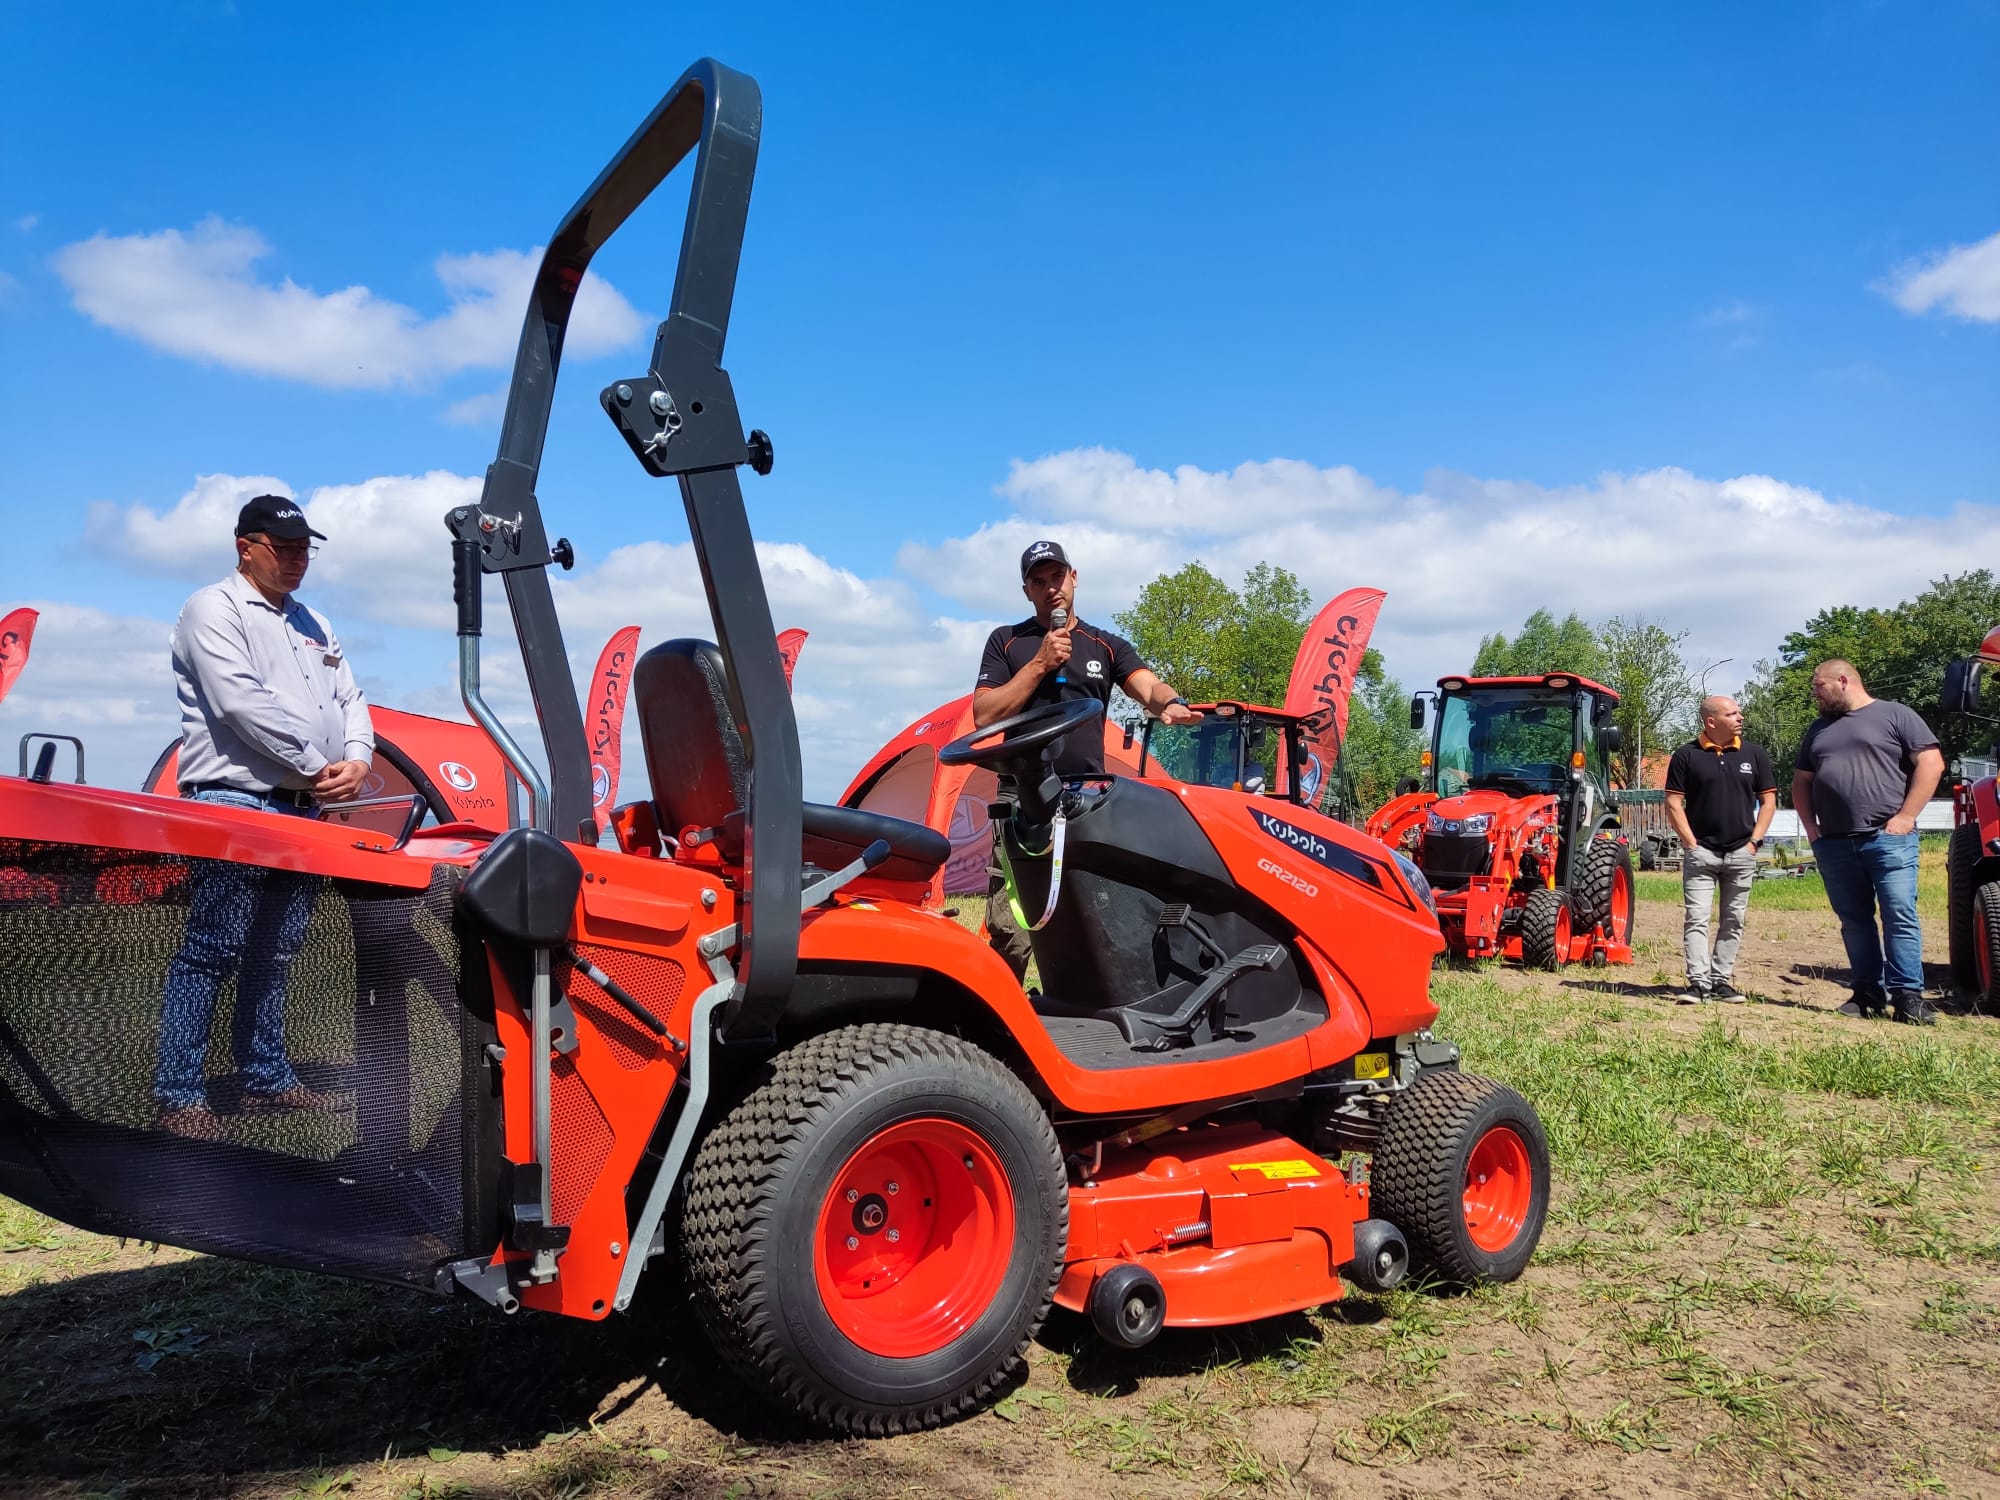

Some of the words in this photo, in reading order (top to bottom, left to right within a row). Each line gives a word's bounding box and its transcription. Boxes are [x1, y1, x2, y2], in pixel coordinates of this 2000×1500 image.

[1301, 615, 1358, 743] Kubota
[593, 651, 626, 756] Kubota
[452, 795, 496, 809] Kubota
[1262, 813, 1327, 860] Kubota
[1257, 857, 1320, 898] GR2120
